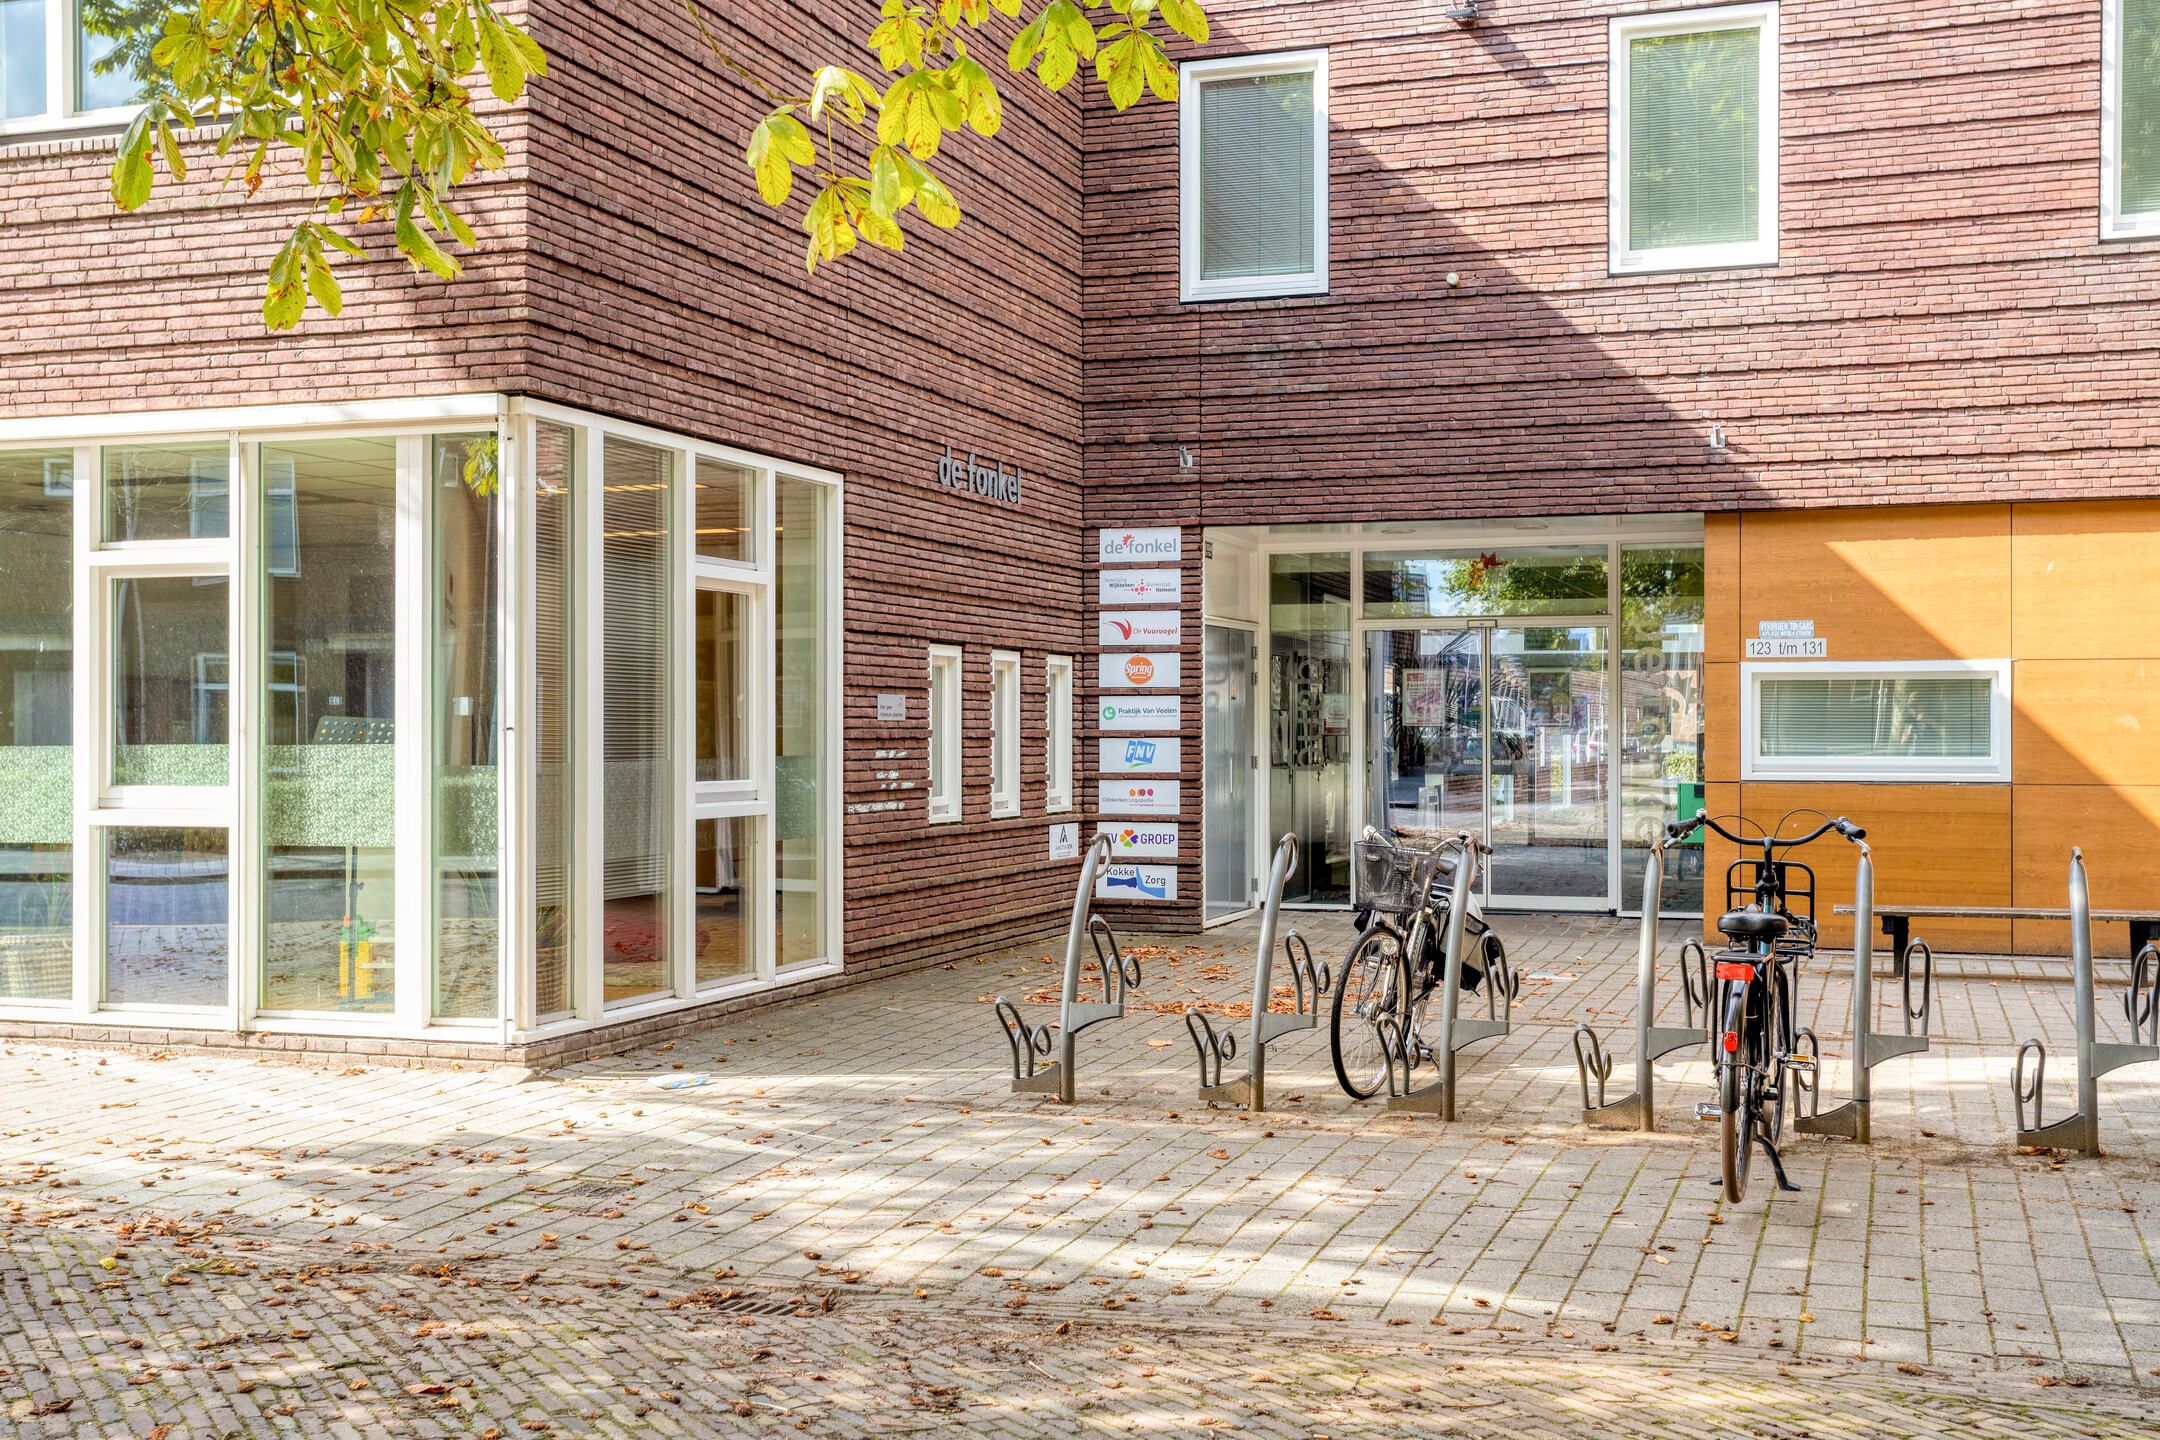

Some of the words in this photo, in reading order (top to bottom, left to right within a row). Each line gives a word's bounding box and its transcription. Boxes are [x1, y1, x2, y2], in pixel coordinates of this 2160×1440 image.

[938, 446, 962, 489] de
[967, 453, 1022, 505] fonkel
[1104, 540, 1123, 554] de
[1129, 538, 1177, 554] fonkel
[1132, 627, 1142, 635] De
[1142, 627, 1178, 636] Vuurvogel
[1750, 641, 1772, 655] 123
[1779, 641, 1798, 655] t/m
[1802, 641, 1823, 655] 131
[1125, 661, 1154, 677] Spring
[1118, 707, 1141, 715] Praktijk
[1126, 744, 1155, 760] FNV
[1140, 833, 1175, 845] GROEP
[1106, 867, 1135, 877] Kokke
[1145, 875, 1166, 887] Zorg
